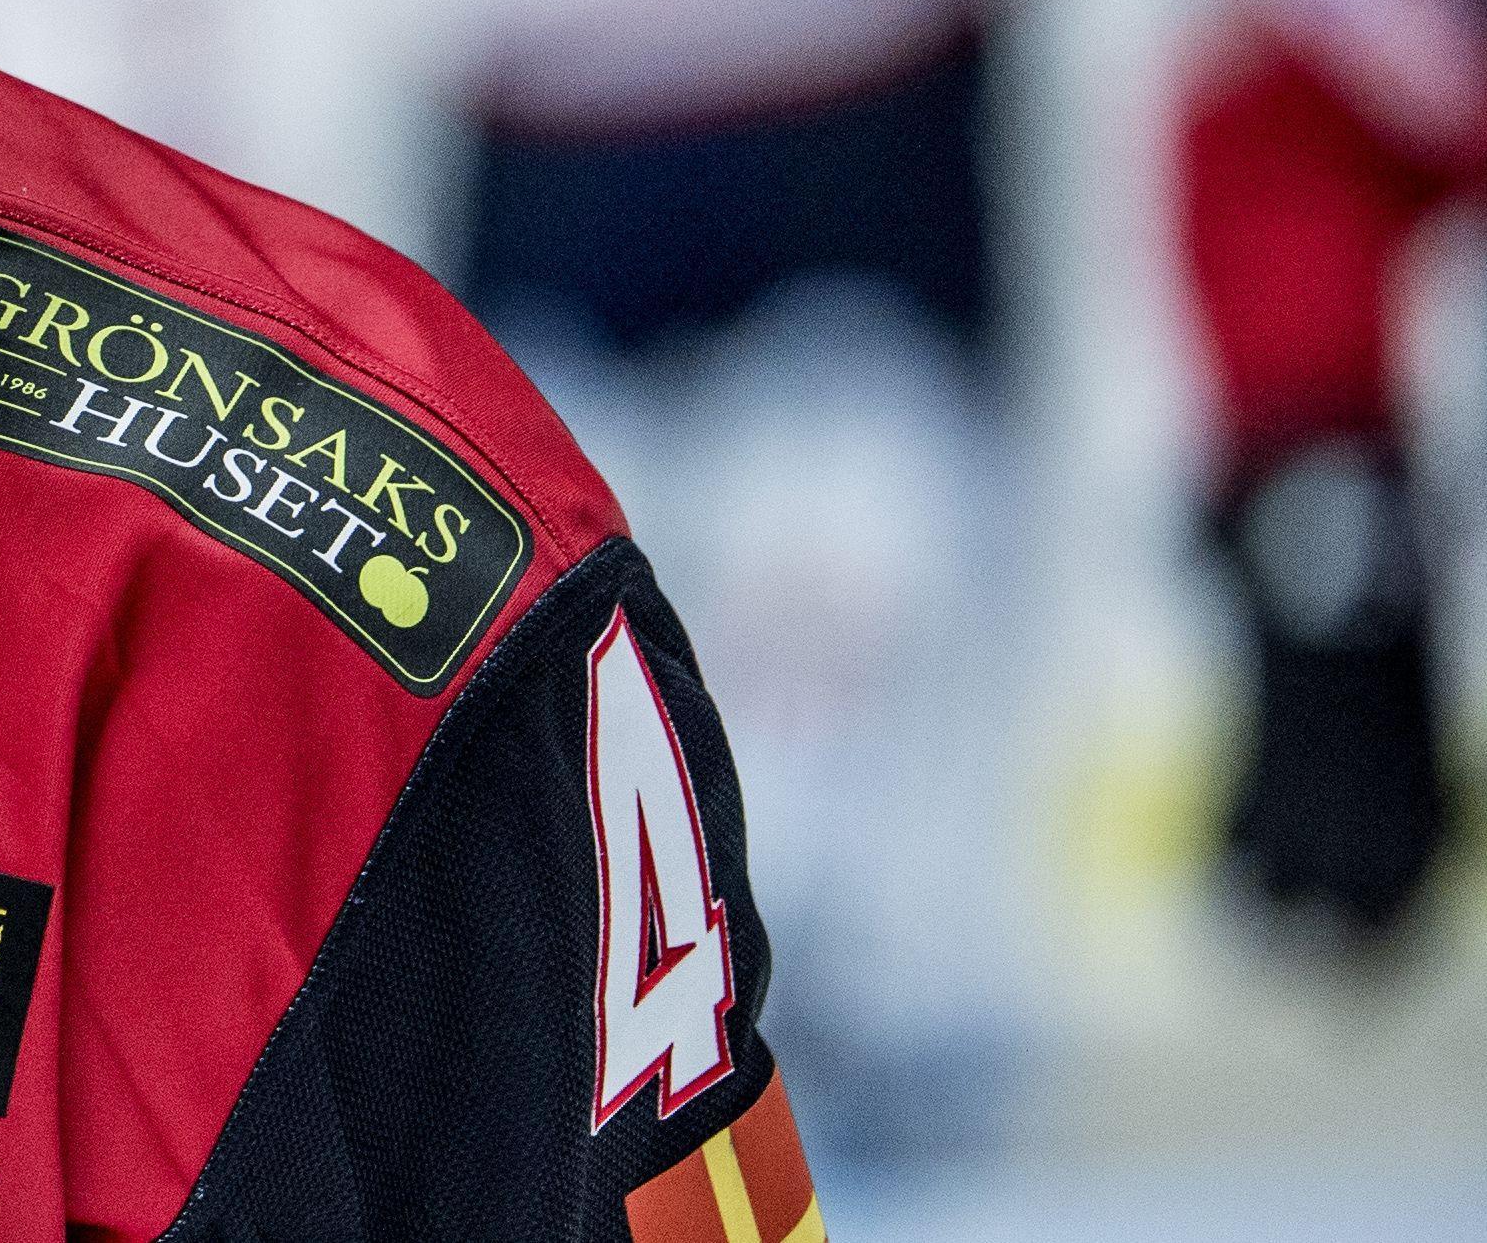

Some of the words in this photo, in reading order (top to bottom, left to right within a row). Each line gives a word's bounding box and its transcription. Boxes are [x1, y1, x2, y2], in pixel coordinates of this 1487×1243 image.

[0, 374, 48, 401] 1986
[49, 377, 387, 574] HUSET
[586, 603, 735, 1136] 4
